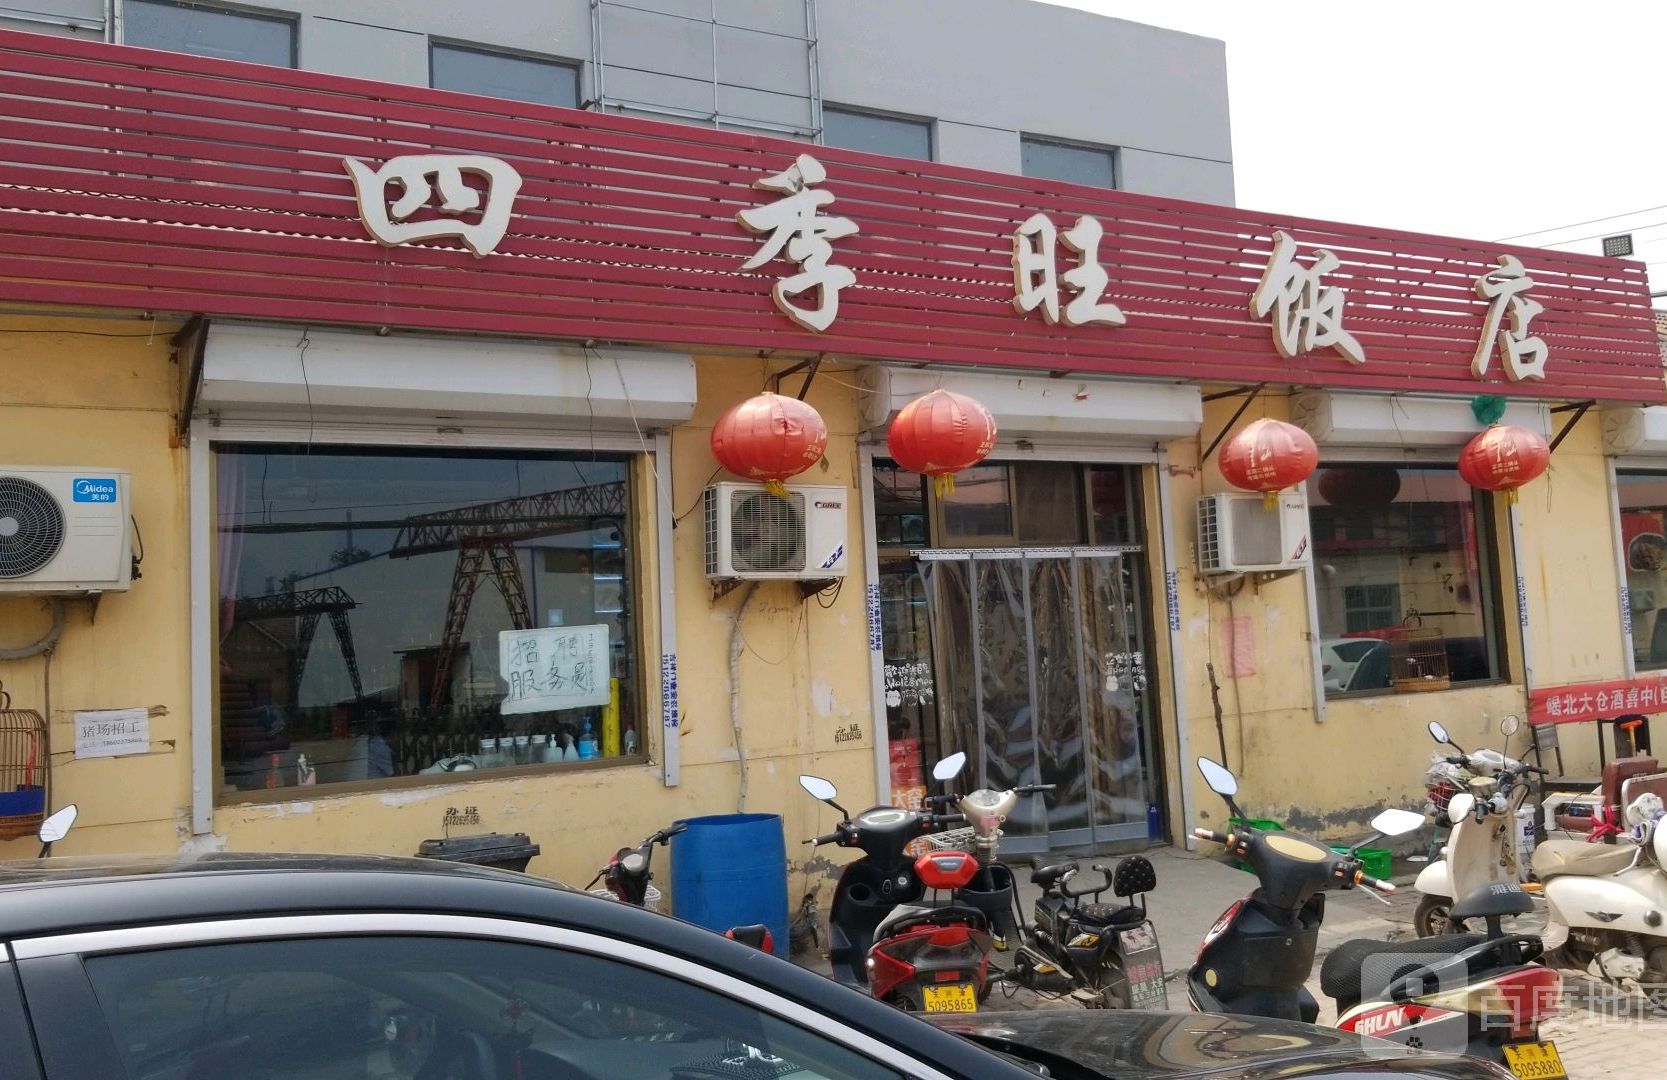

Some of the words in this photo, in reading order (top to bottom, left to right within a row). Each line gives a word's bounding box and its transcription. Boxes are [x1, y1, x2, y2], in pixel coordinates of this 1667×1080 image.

[343, 153, 1549, 382] 四季旺饭店
[83, 484, 114, 493] Midea
[91, 493, 109, 501] 美的
[511, 636, 579, 666] 招聘
[510, 662, 588, 702] 服务员
[81, 721, 142, 738] 猪场招工
[446, 806, 479, 816] 办证
[928, 998, 974, 1012] 5095865
[1513, 1059, 1562, 1078] 5095880
